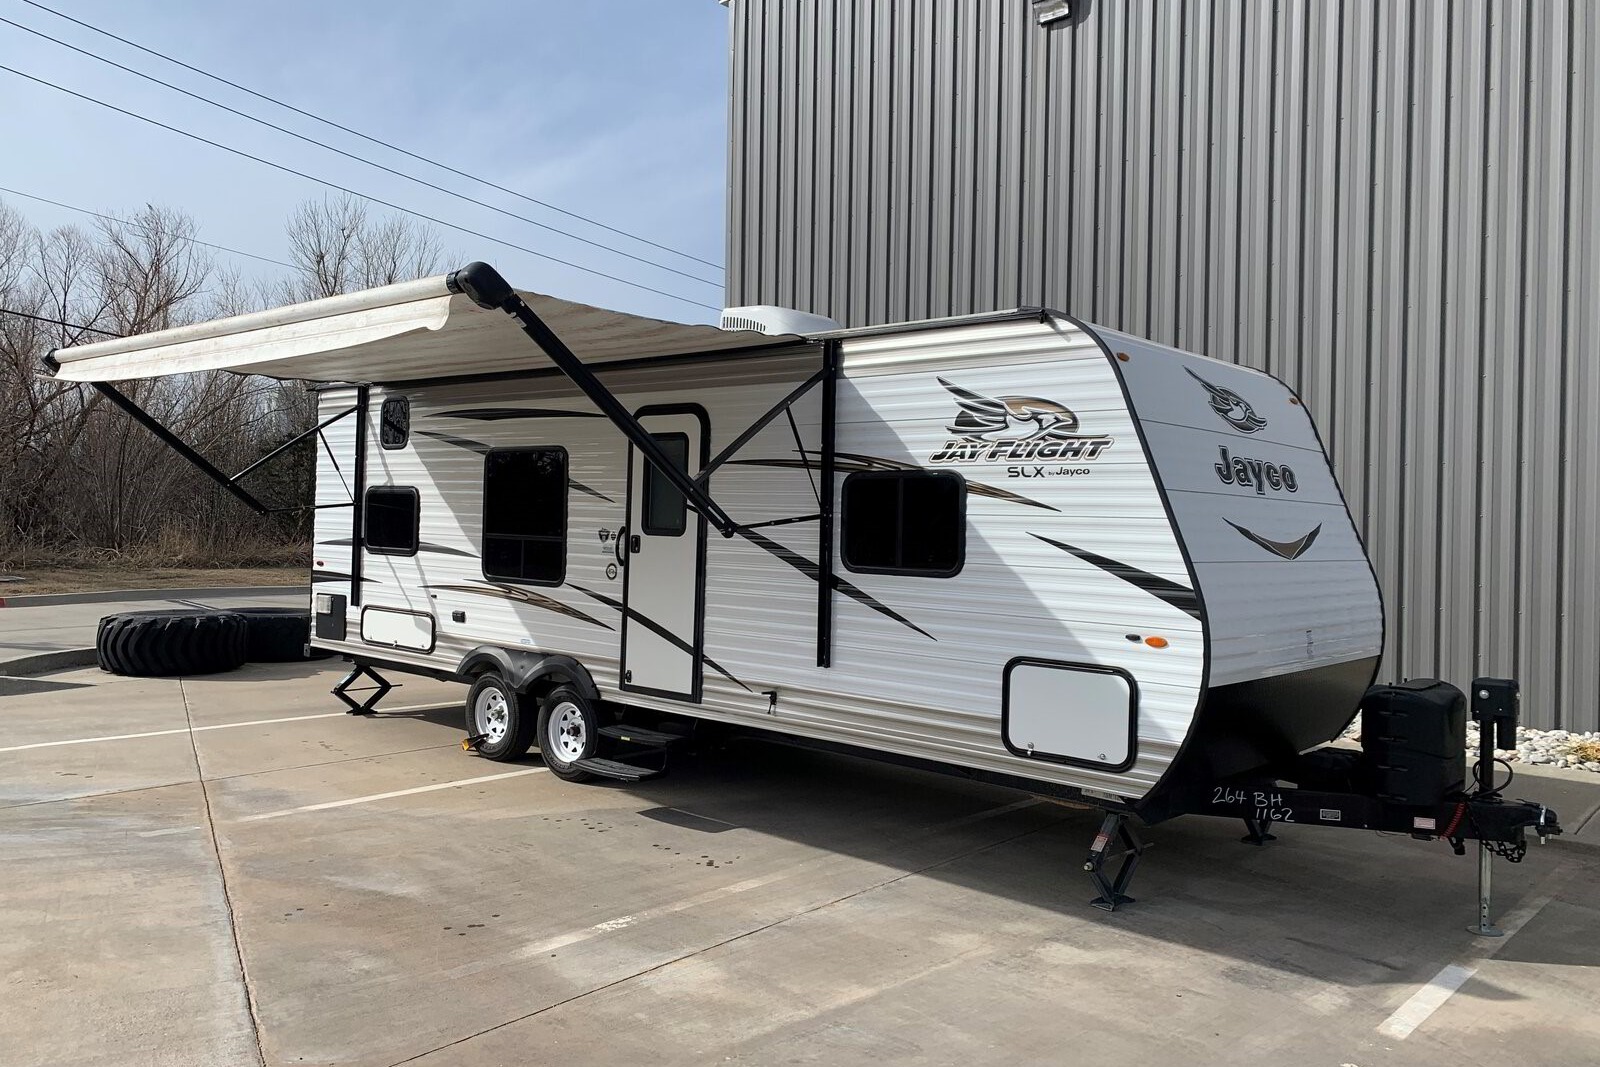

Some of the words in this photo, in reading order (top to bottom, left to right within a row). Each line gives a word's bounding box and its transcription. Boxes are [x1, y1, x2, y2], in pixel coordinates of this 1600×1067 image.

[929, 440, 989, 463] JAY
[985, 438, 1114, 462] FLIGHT
[1007, 466, 1046, 478] SLX
[1055, 466, 1091, 476] Jayco
[1214, 444, 1299, 495] Jayco
[1212, 786, 1247, 804] 264
[1253, 792, 1283, 807] BH
[1256, 807, 1295, 822] 1162
